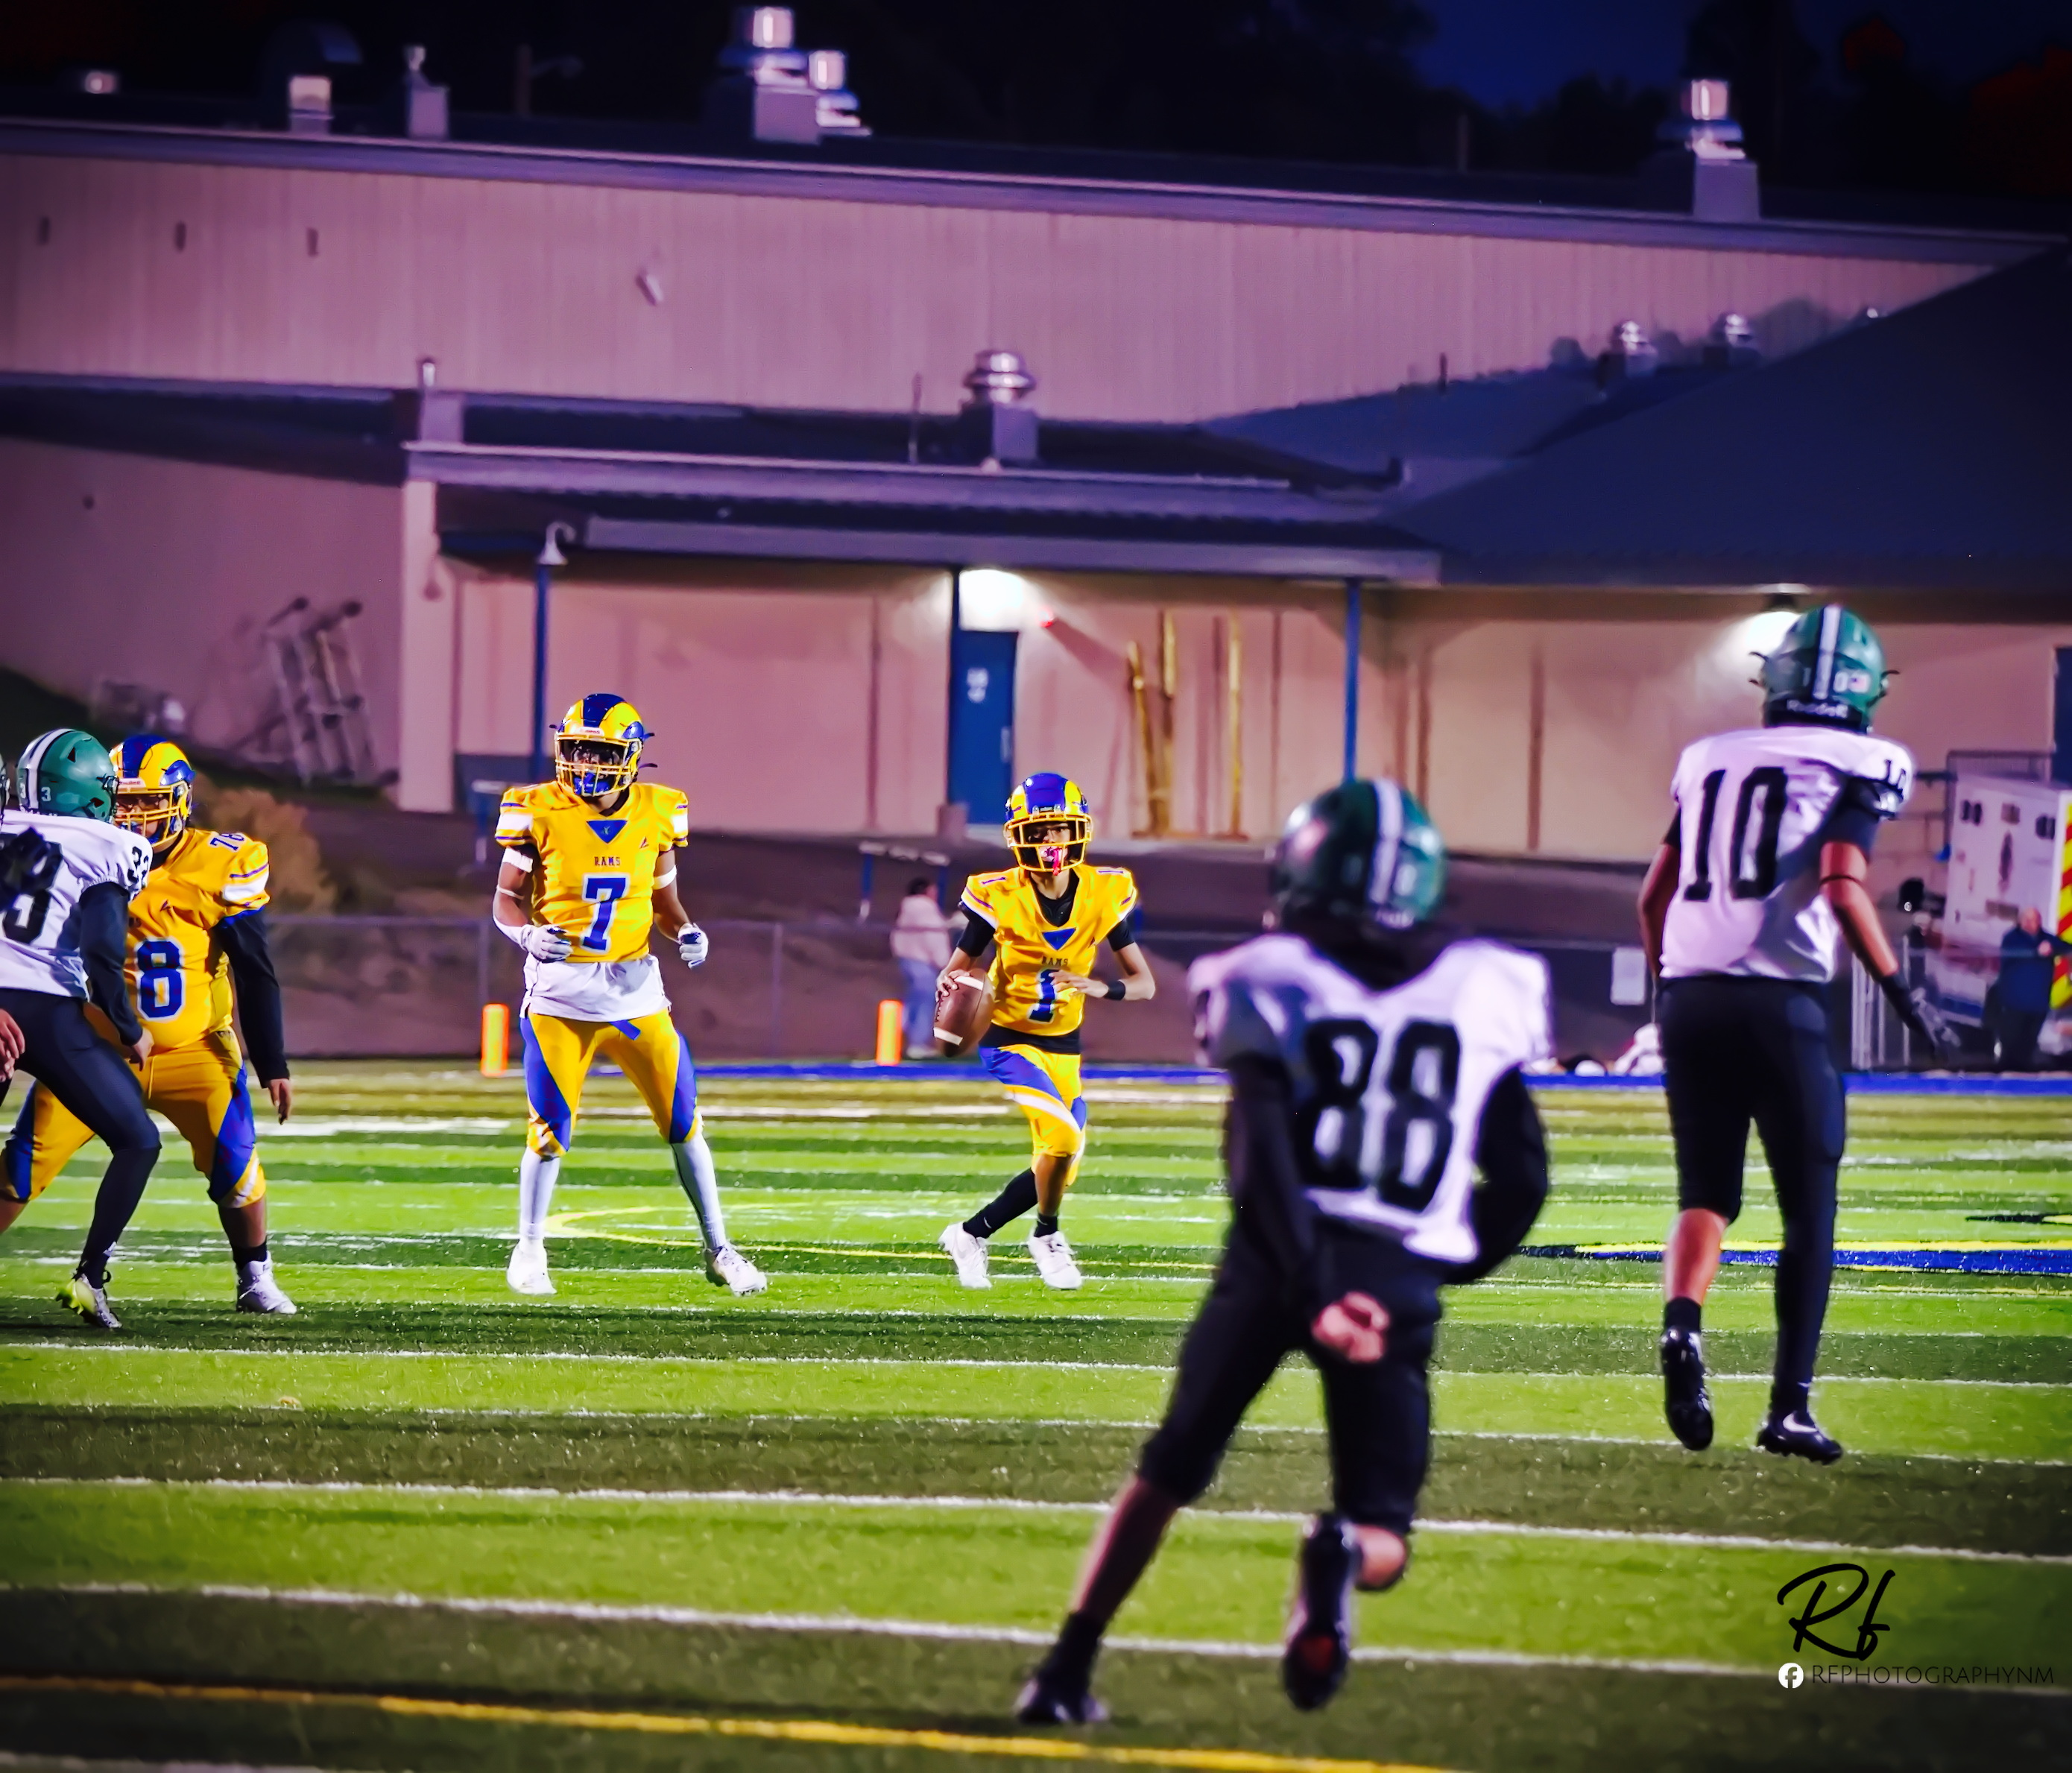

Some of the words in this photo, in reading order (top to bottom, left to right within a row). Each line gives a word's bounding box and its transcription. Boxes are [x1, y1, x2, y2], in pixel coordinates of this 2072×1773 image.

[594, 856, 621, 866] RAMS
[1683, 765, 1788, 902] 10
[581, 873, 629, 952] 7
[135, 939, 186, 1020] 8
[1029, 968, 1060, 1023] 1
[1041, 955, 1069, 966] RAMS
[1295, 1020, 1462, 1213] 88
